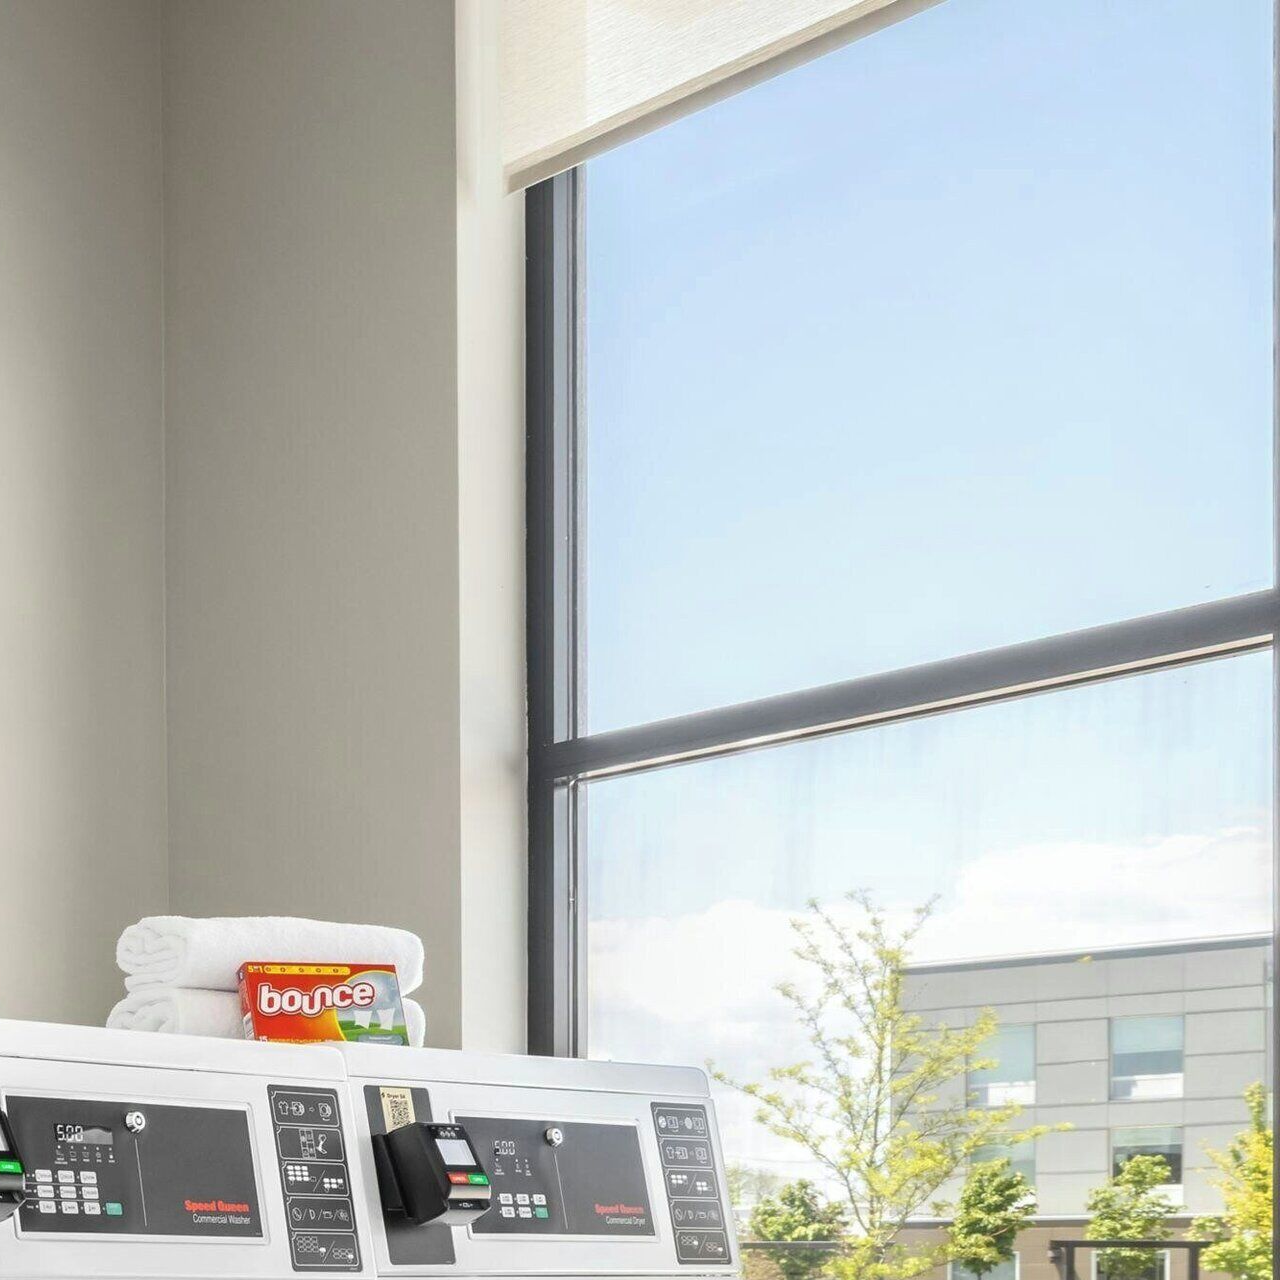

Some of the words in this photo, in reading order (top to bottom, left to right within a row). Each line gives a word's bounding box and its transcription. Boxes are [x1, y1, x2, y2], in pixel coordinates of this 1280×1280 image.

[258, 982, 376, 1017] bounce
[56, 1124, 84, 1142] 5.00
[184, 1199, 217, 1213] Speed
[217, 1200, 250, 1212] Queen
[595, 1204, 618, 1214] Speed
[620, 1204, 644, 1214] Queen
[192, 1213, 227, 1224] Commercial
[228, 1215, 251, 1225] Washer
[606, 1216, 632, 1224] Commercial
[633, 1217, 645, 1227] Dryer
